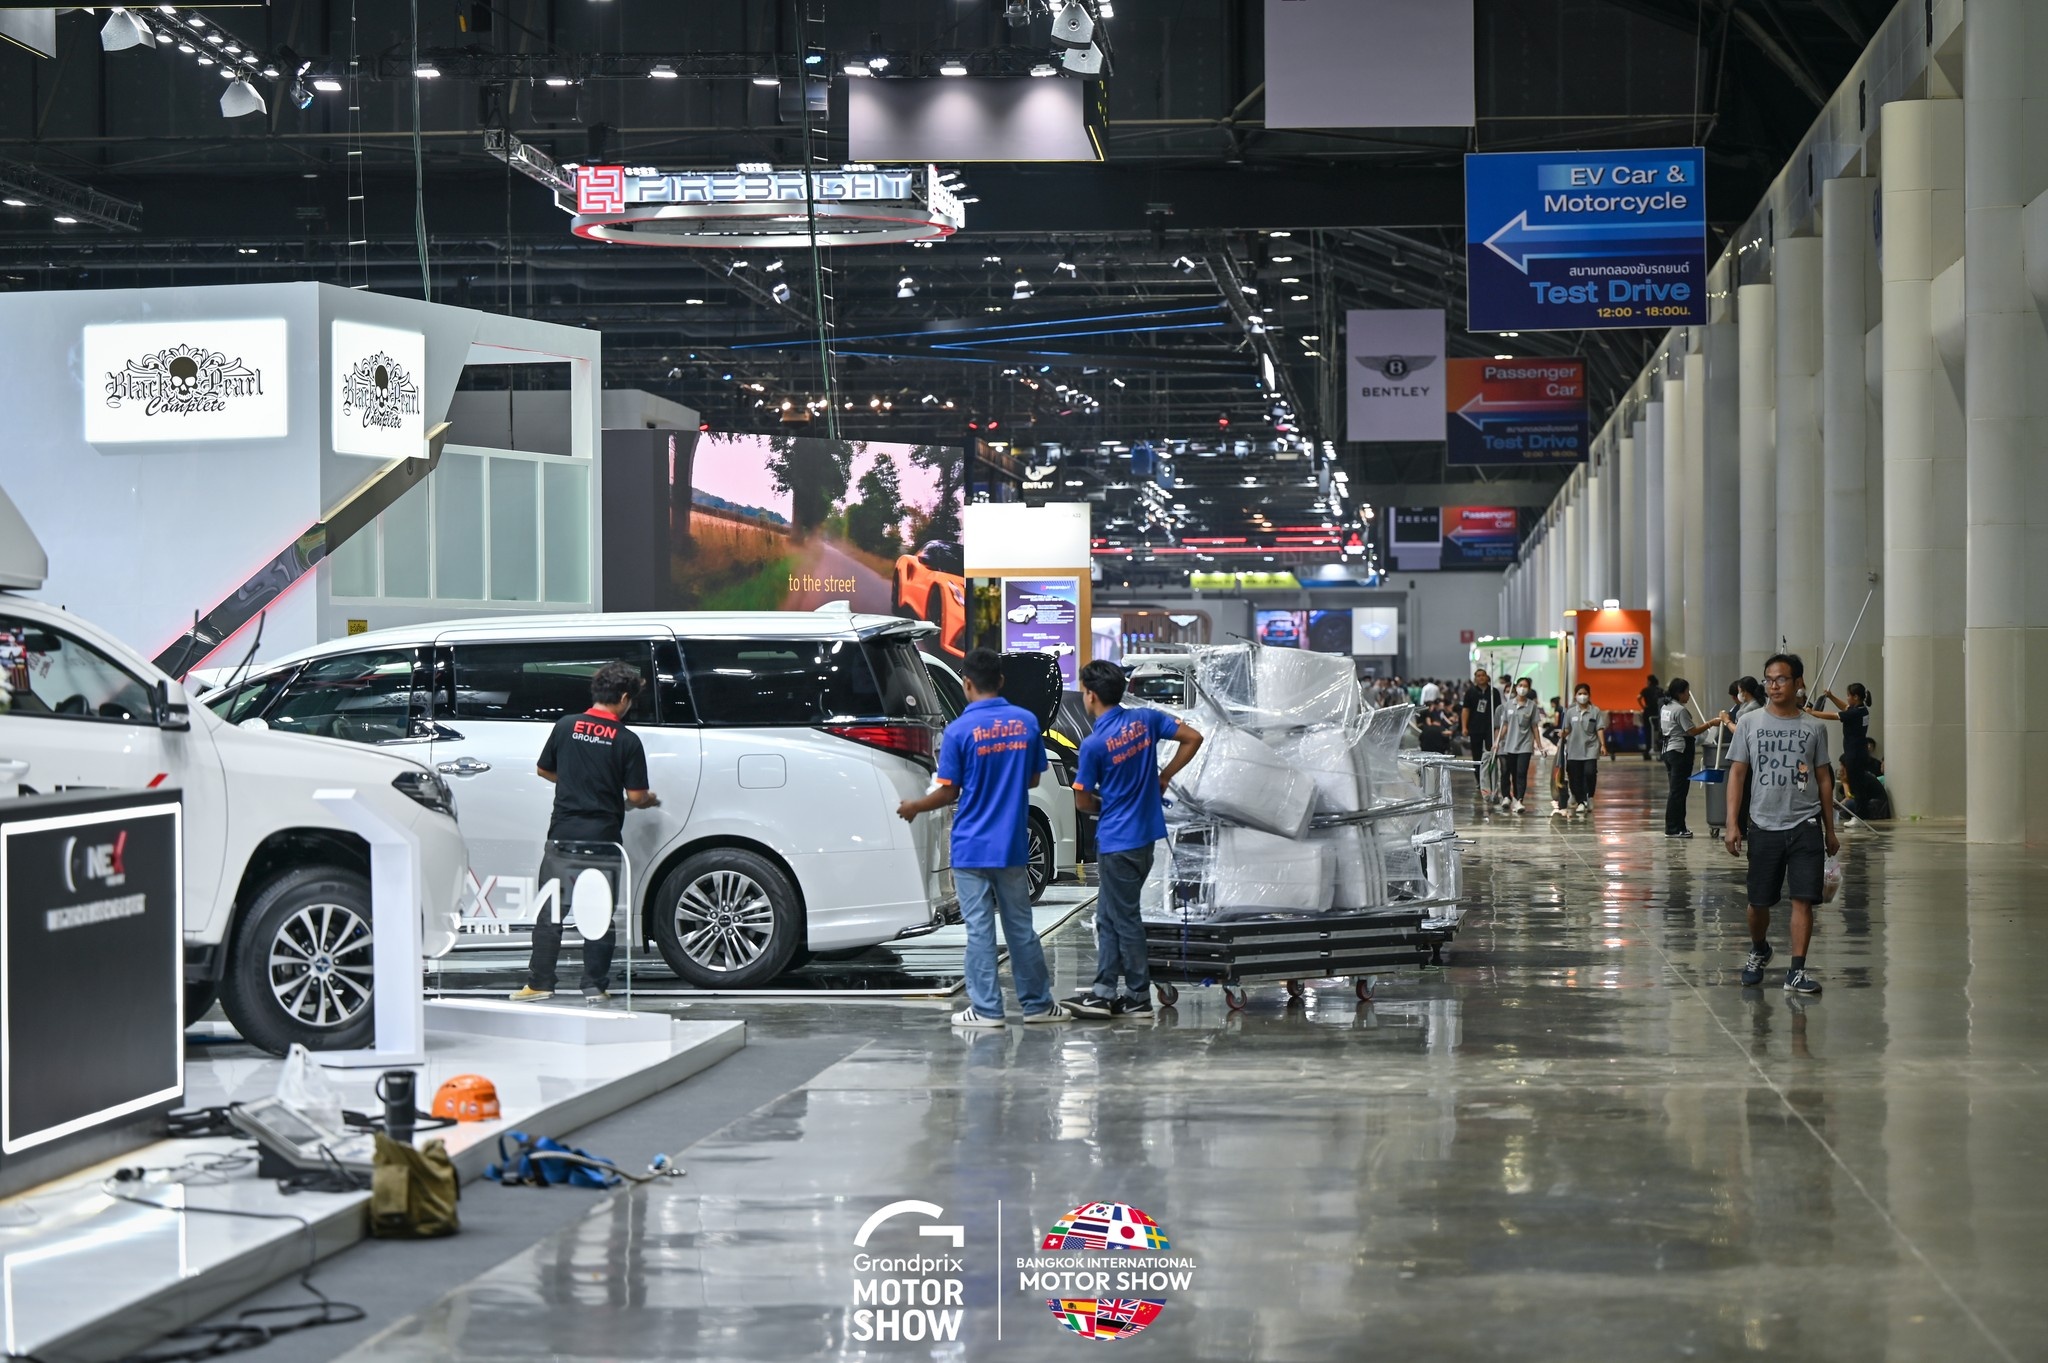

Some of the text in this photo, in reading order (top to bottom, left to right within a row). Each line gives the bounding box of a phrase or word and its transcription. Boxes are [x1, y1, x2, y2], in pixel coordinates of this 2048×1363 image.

[1570, 165, 1686, 186] EV Car &
[638, 174, 911, 200] FIREBRGHT
[1544, 191, 1687, 214] Motorcycle
[1569, 261, 1690, 277] สนามทดลองขับรถยนต์
[1529, 279, 1691, 304] Test Drive
[1597, 307, 1632, 318] 12:00
[1485, 366, 1577, 380] Passenger
[105, 368, 264, 408] Black Pearl
[343, 373, 420, 416] Black Pearl
[1362, 386, 1430, 398] BENTLEY
[1546, 383, 1577, 397] Car
[145, 395, 227, 418] Complete
[362, 406, 402, 432] Complete
[1482, 434, 1578, 449] Test Drive
[1397, 515, 1438, 524] ZEEKR
[1462, 510, 1512, 520] Passenger
[1495, 520, 1512, 529] Car
[788, 575, 856, 593] to the street
[1589, 641, 1639, 659] DRIVE
[572, 732, 600, 744] GROUP
[573, 721, 617, 739] ETON
[1756, 728, 1811, 741] BEVERLY
[1758, 740, 1807, 754] HILLS
[87, 831, 128, 879] NEX
